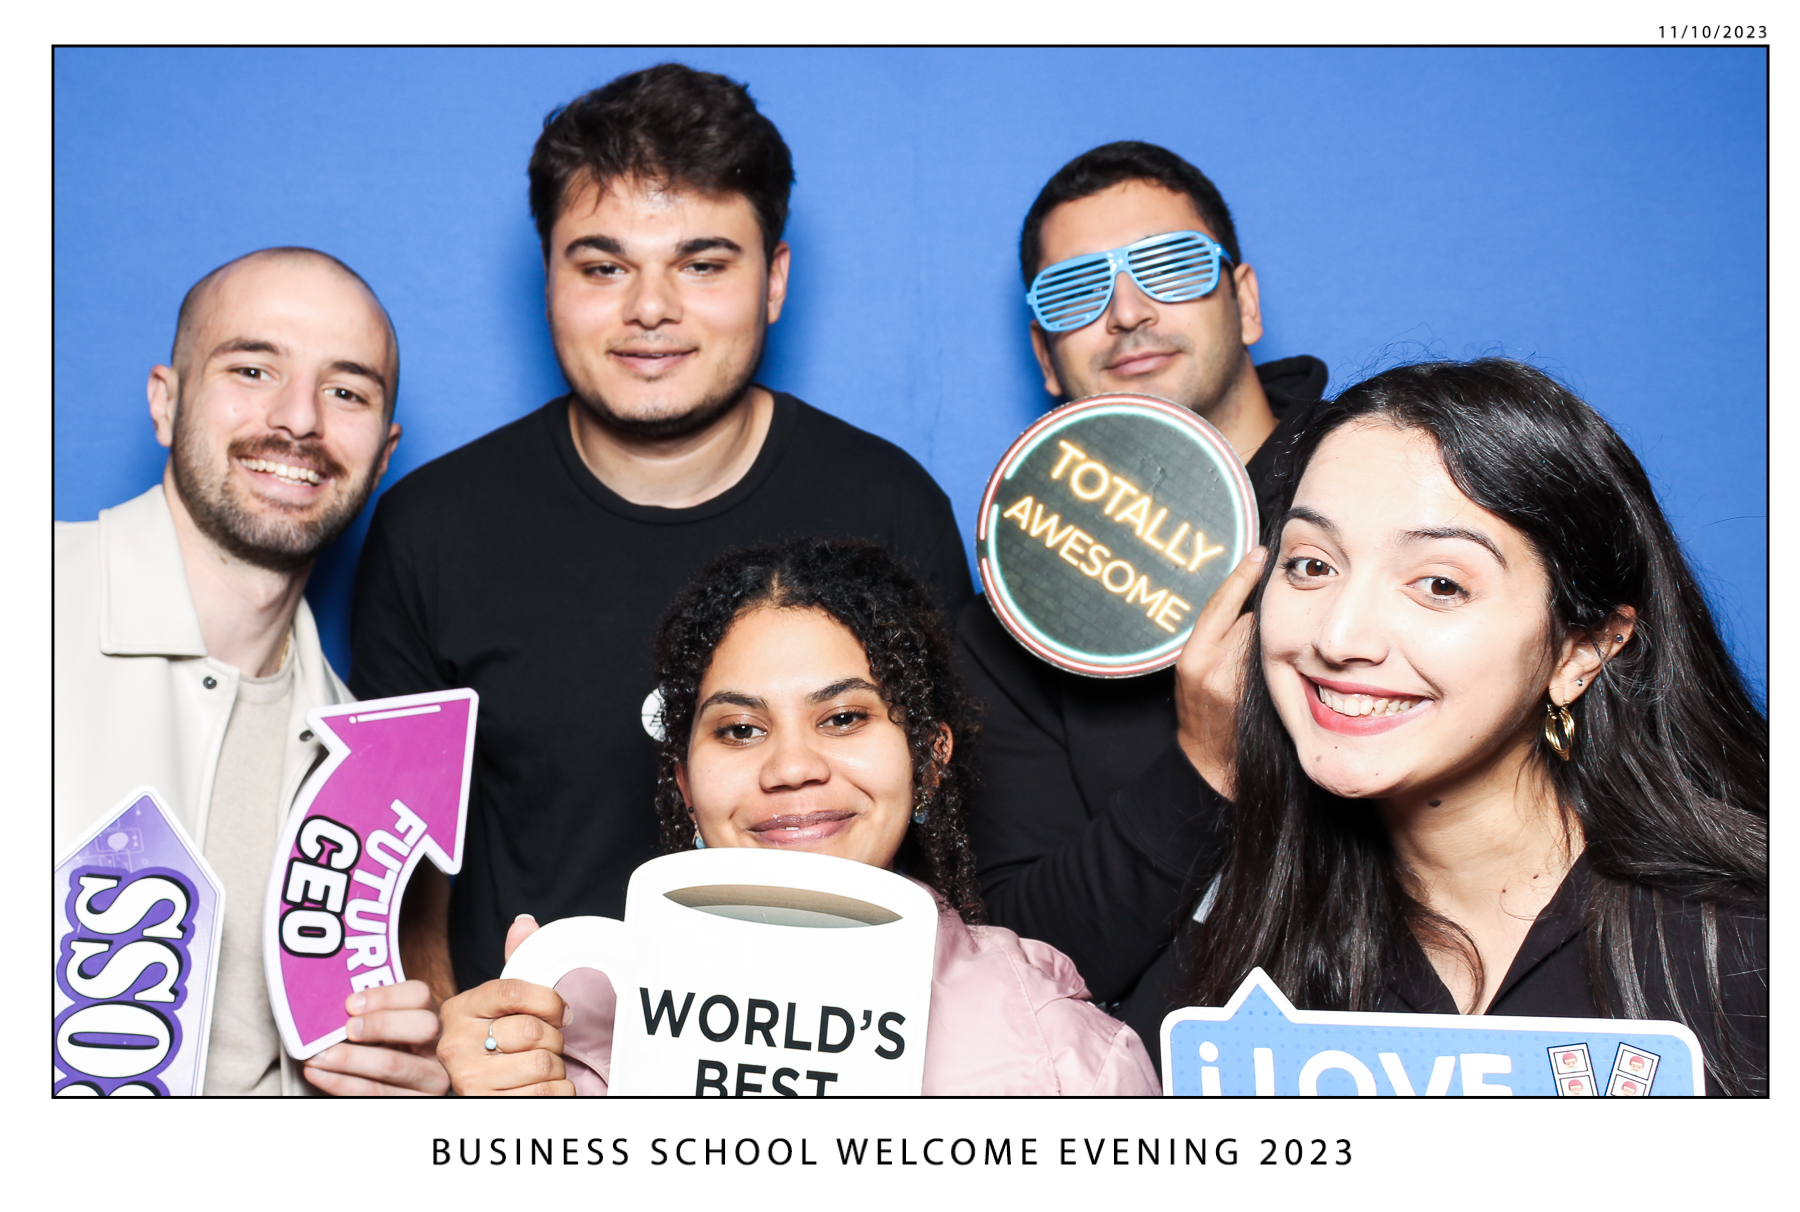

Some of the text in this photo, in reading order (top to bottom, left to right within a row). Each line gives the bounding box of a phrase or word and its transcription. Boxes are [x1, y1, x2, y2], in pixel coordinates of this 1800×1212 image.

[1003, 495, 1192, 633] AWESOME
[1051, 440, 1225, 573] TOTALLY
[279, 815, 362, 958] CEO
[54, 873, 190, 1096] OSS
[639, 987, 906, 1060] WORLD'S
[695, 1059, 838, 1096] BEST
